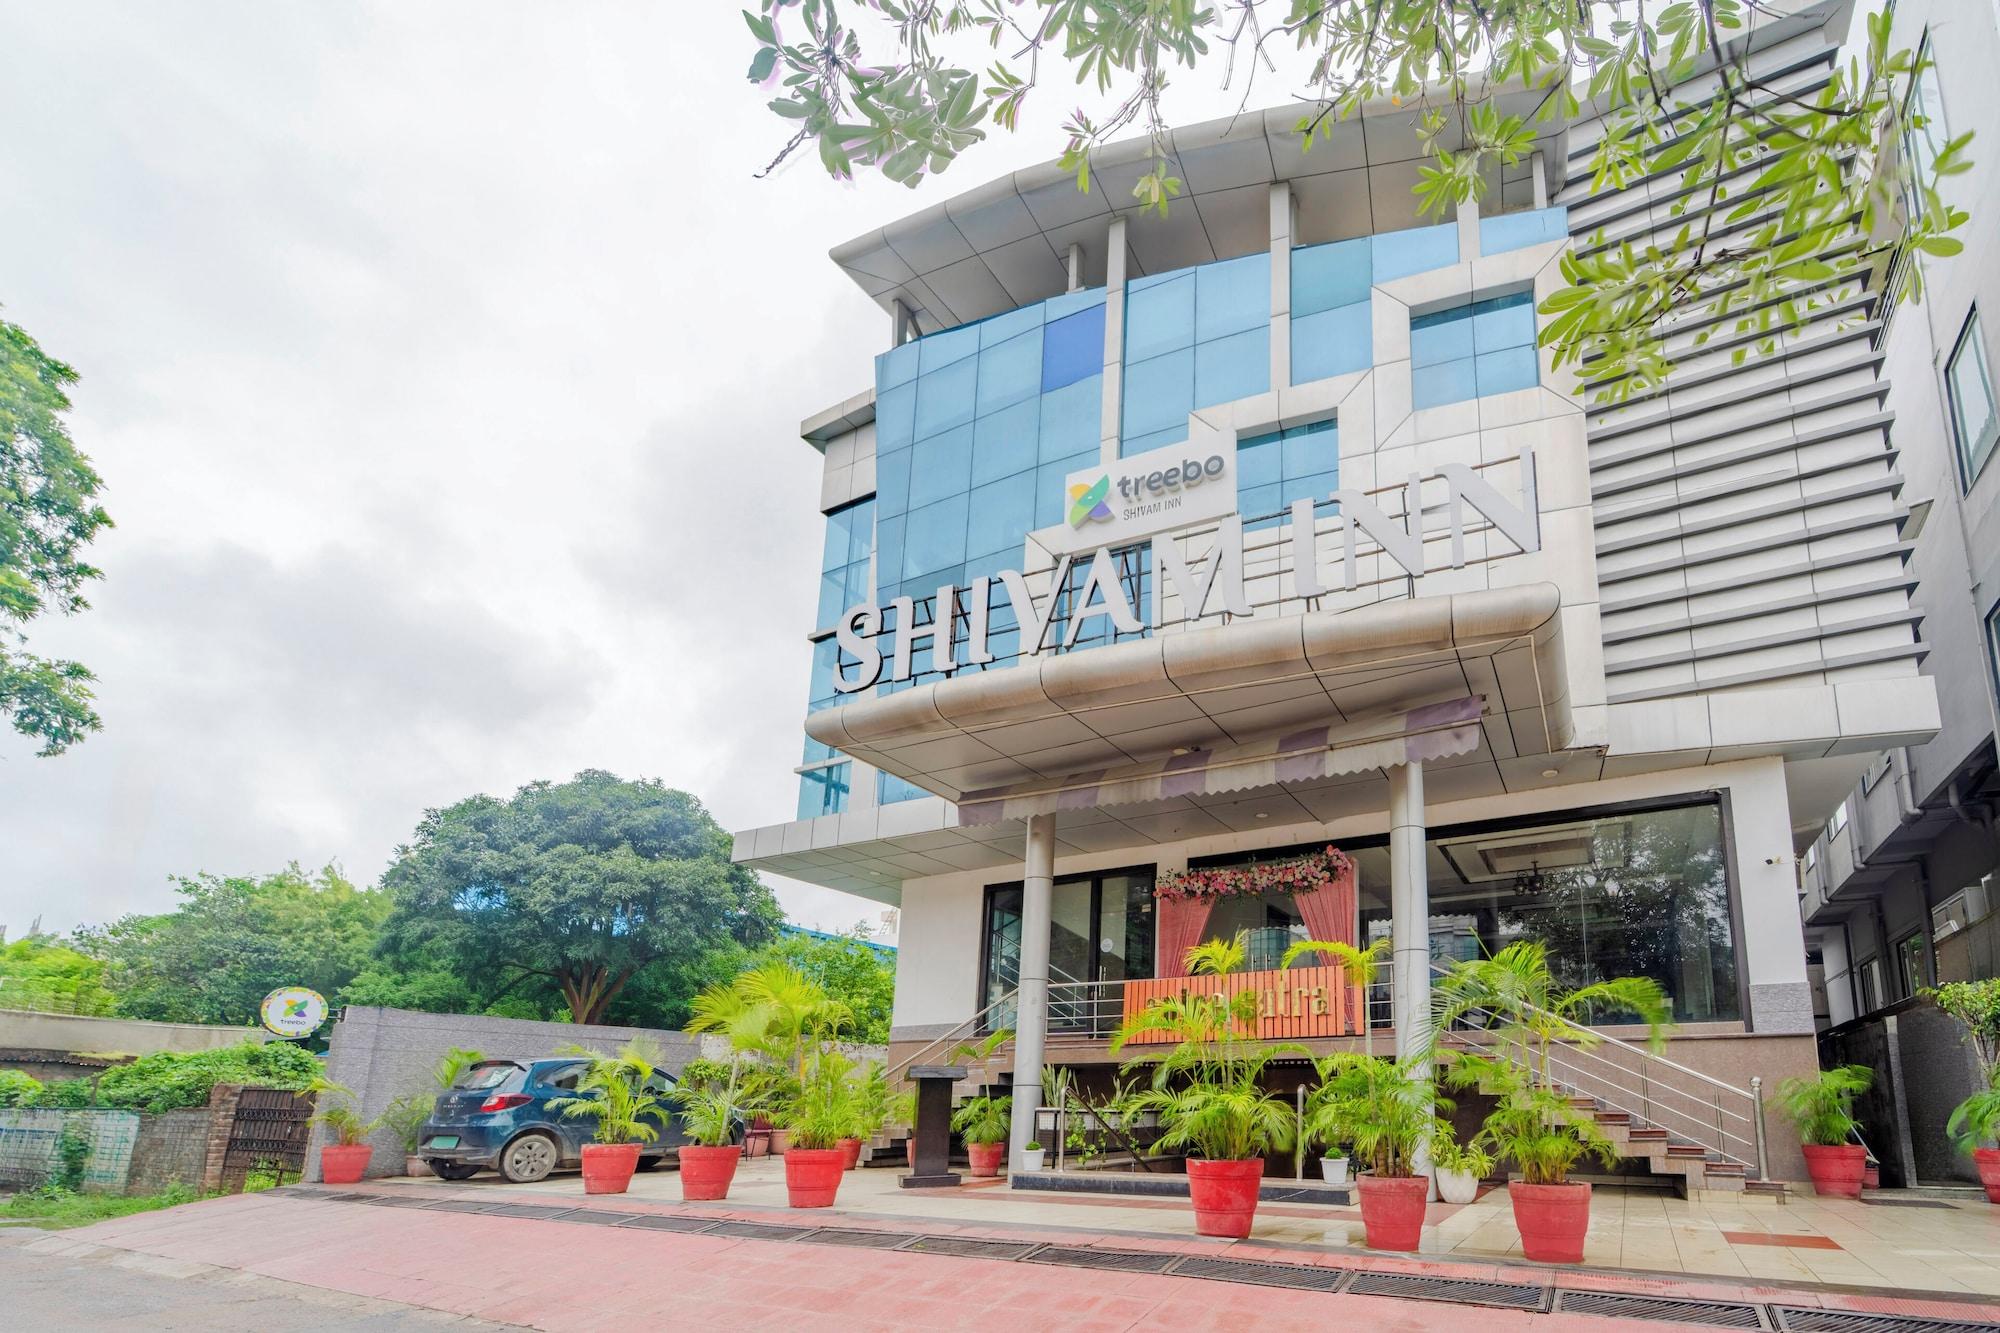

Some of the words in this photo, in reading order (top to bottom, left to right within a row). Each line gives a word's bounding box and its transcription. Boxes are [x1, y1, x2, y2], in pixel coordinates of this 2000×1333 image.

[1117, 455, 1225, 498] treebo
[1123, 502, 1161, 520] SHIVAM
[1164, 497, 1182, 511] INN
[832, 513, 1254, 694] SHIVAM
[1291, 445, 1541, 598] INN
